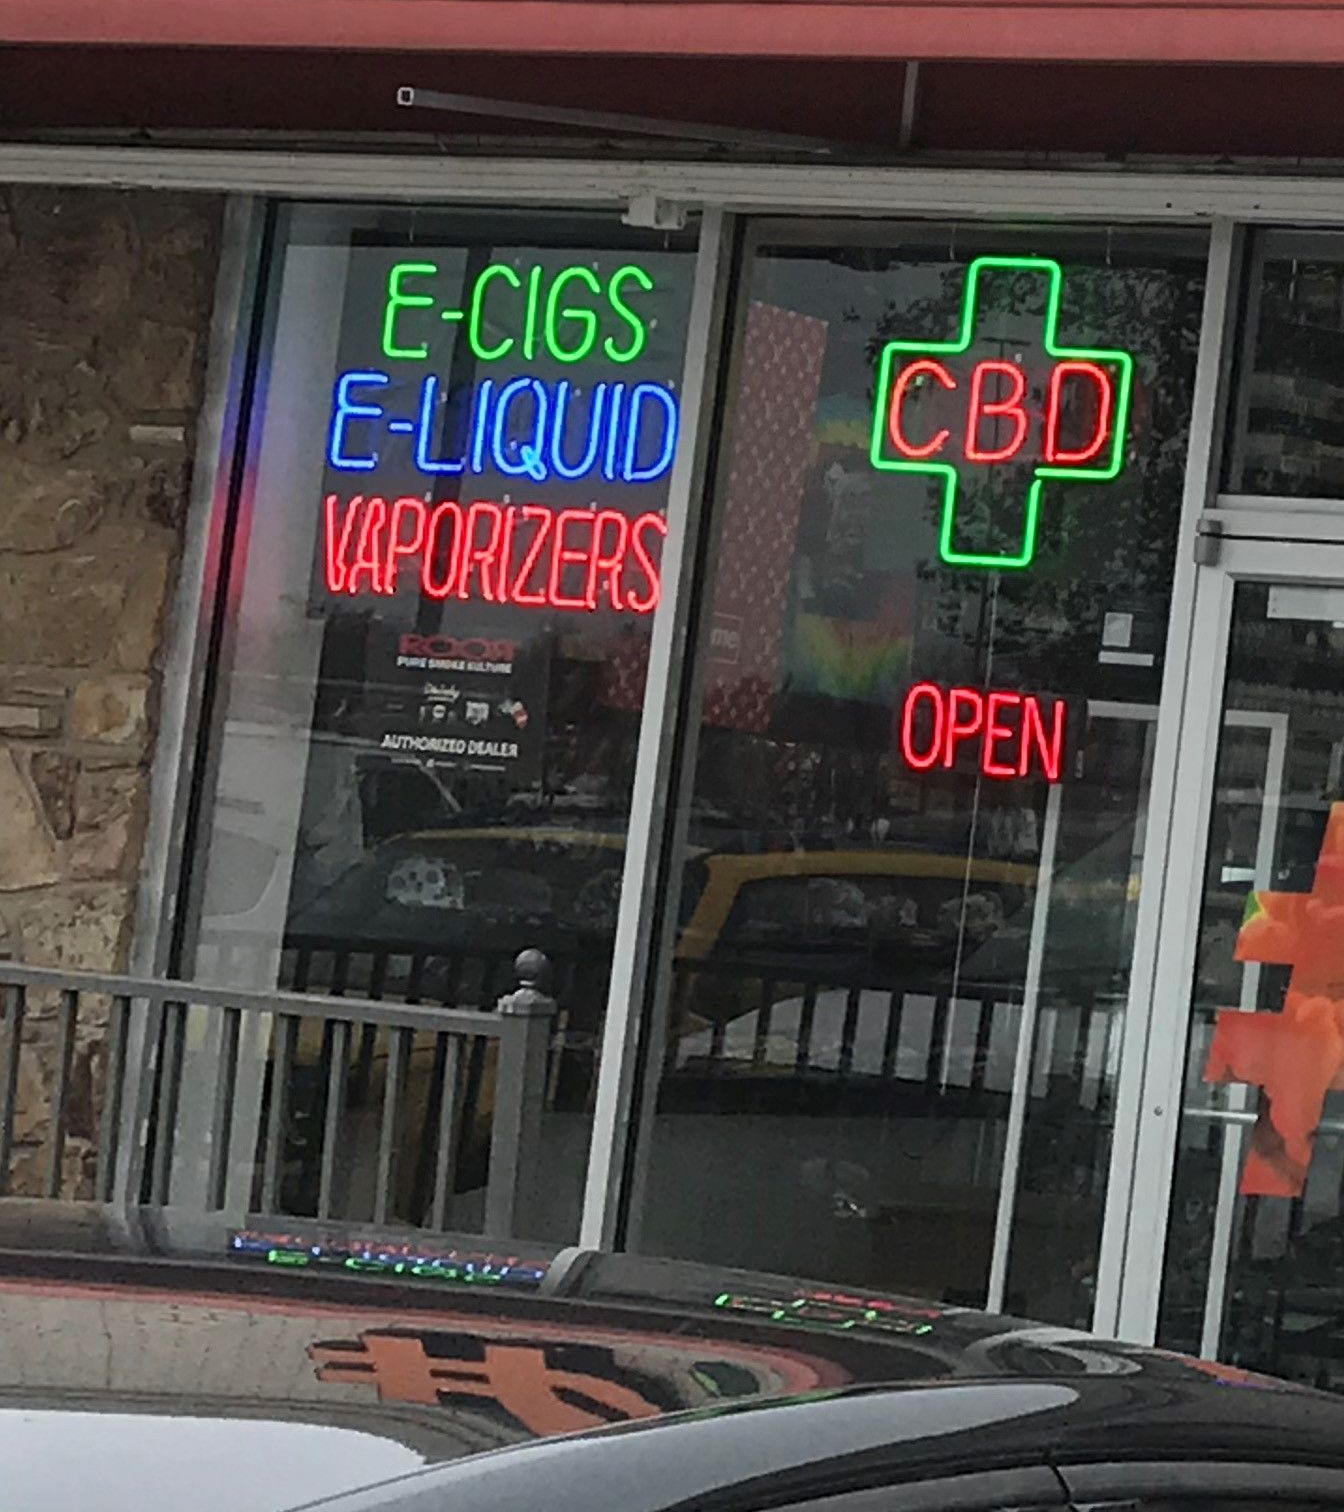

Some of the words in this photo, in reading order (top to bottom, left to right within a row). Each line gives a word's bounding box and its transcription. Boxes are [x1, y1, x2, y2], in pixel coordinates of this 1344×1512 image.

[384, 263, 653, 363] E-CIGS
[328, 372, 677, 482] E-LIQUID
[887, 360, 1114, 464] CBD
[324, 495, 668, 612] VAPORIZERS
[380, 734, 467, 755] AUTHORIZED
[467, 740, 519, 759] DEALER
[902, 681, 1066, 780] OPEN
